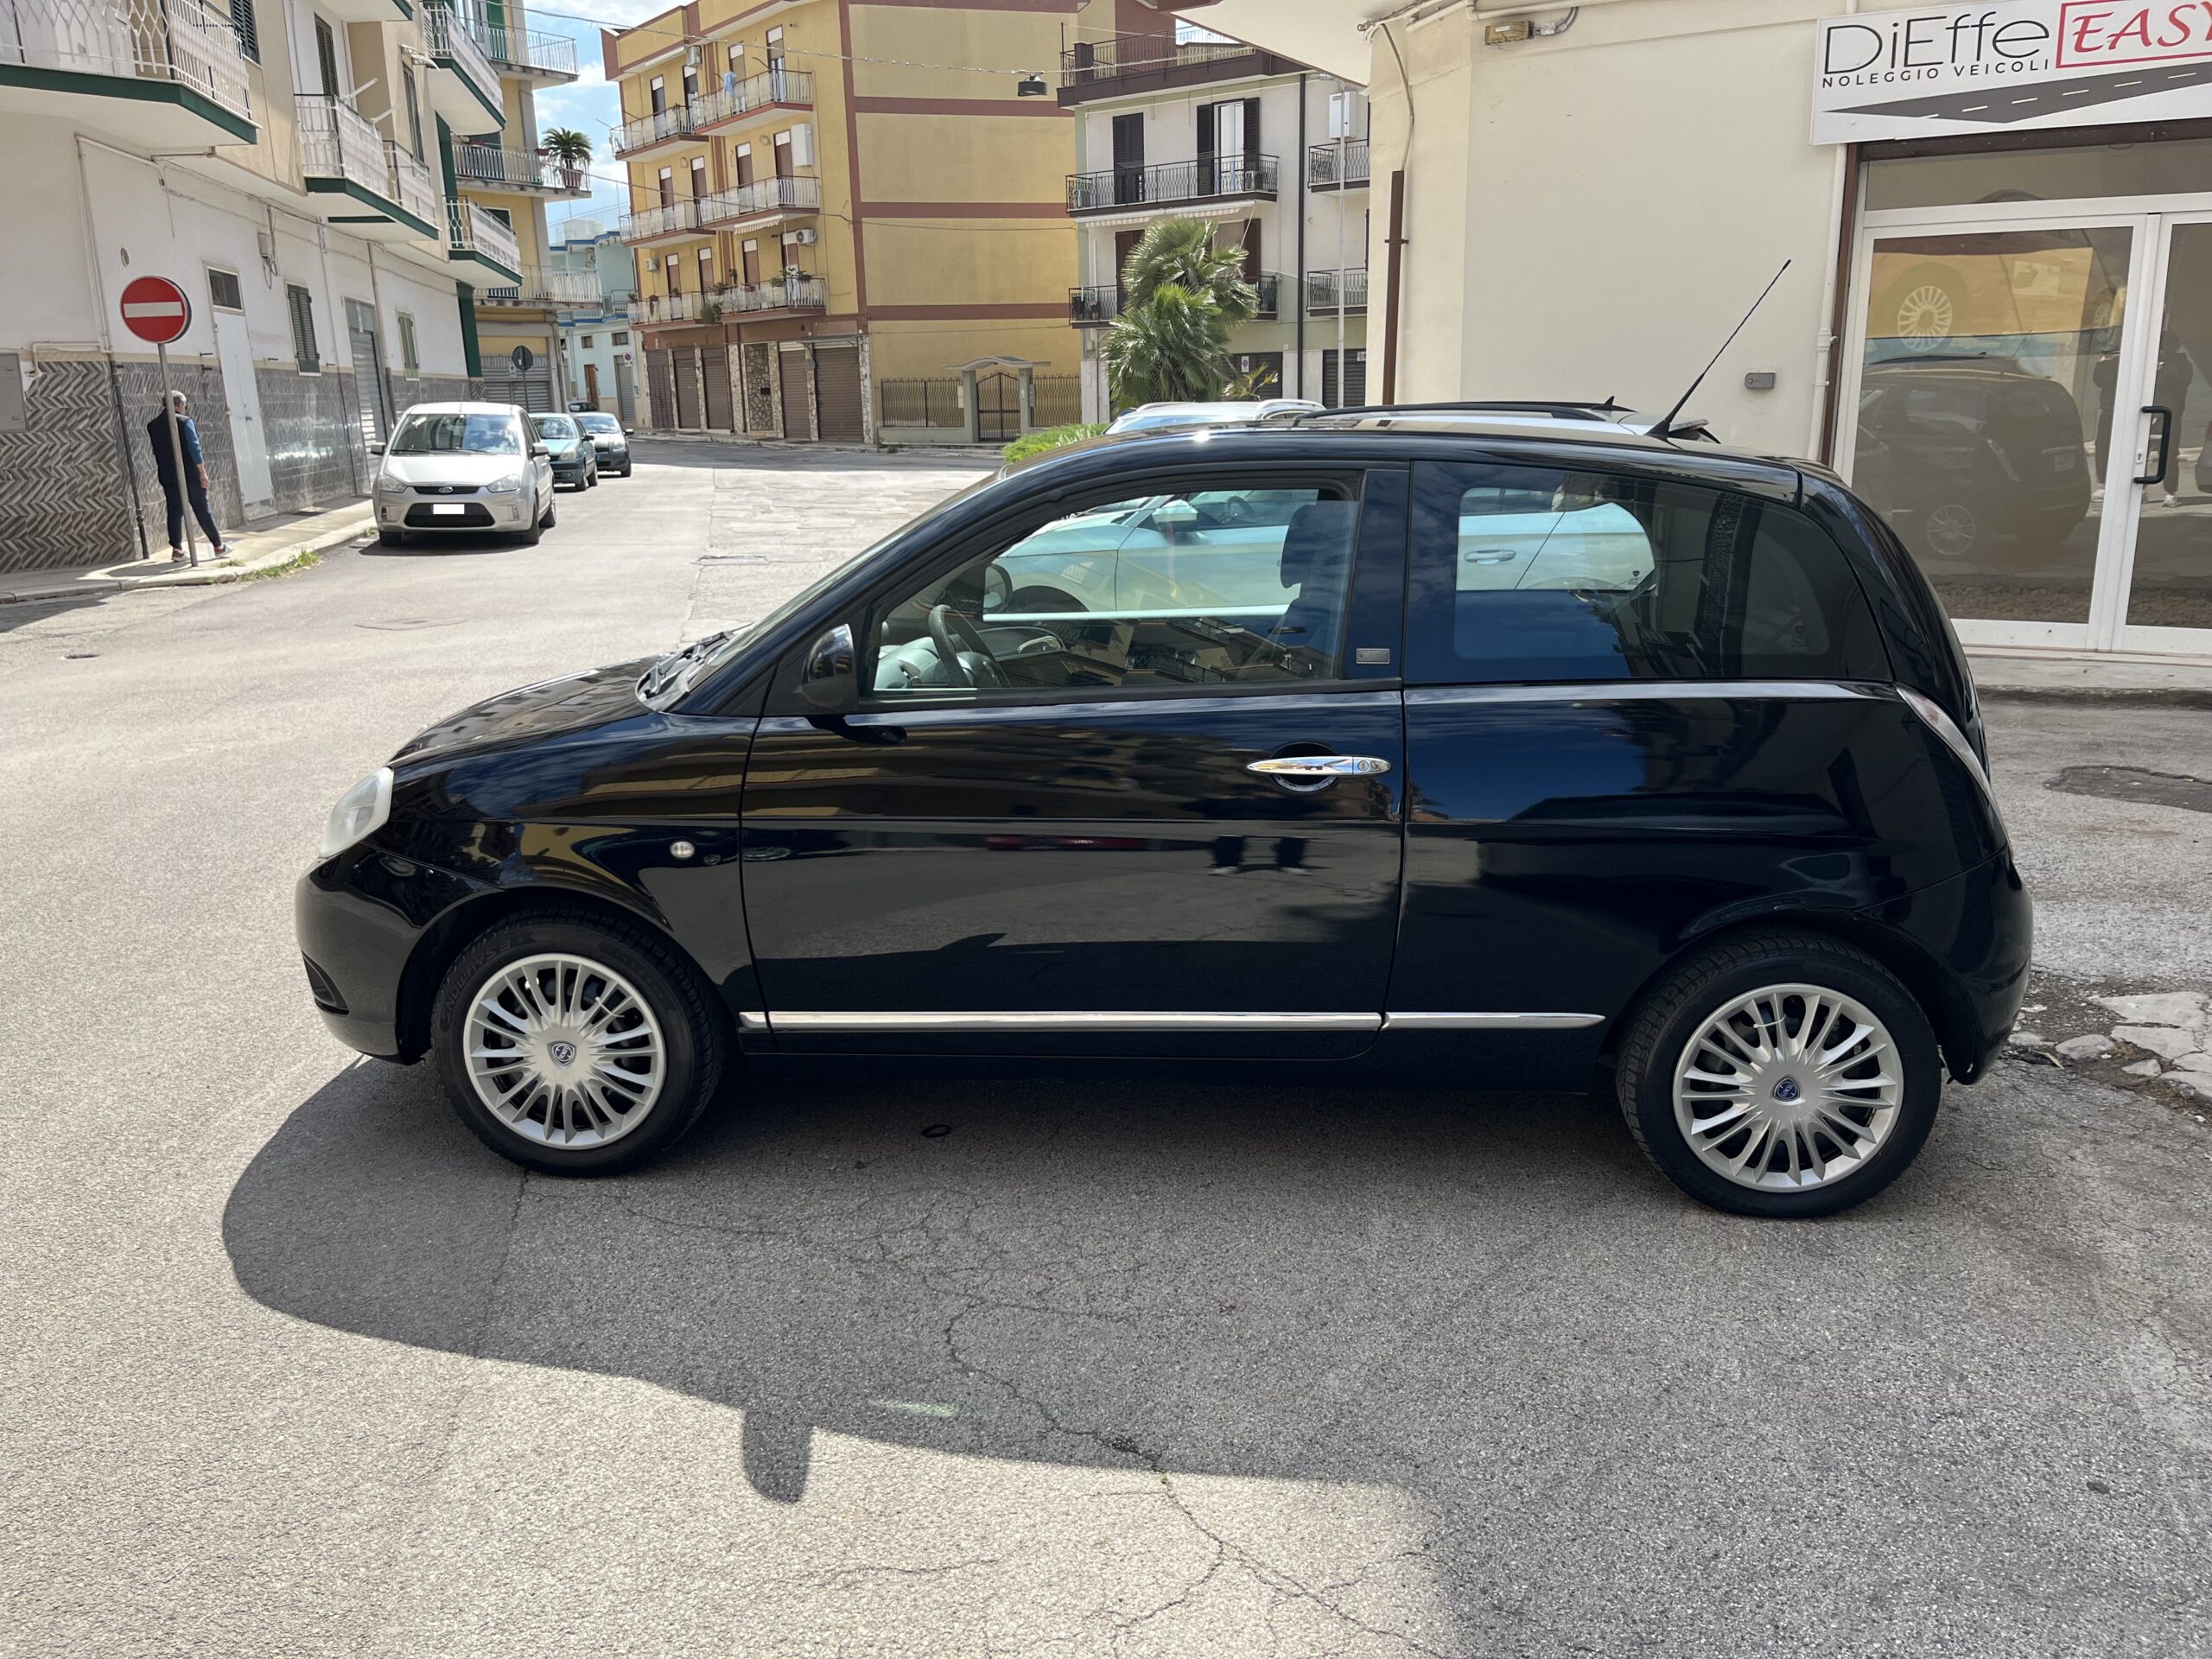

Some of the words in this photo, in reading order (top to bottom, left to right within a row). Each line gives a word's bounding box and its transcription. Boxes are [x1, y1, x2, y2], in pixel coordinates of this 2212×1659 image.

[1824, 11, 2050, 74] DiEffe
[1822, 67, 1939, 88] NOLEGGIO
[1954, 59, 2049, 77] VEICOLI
